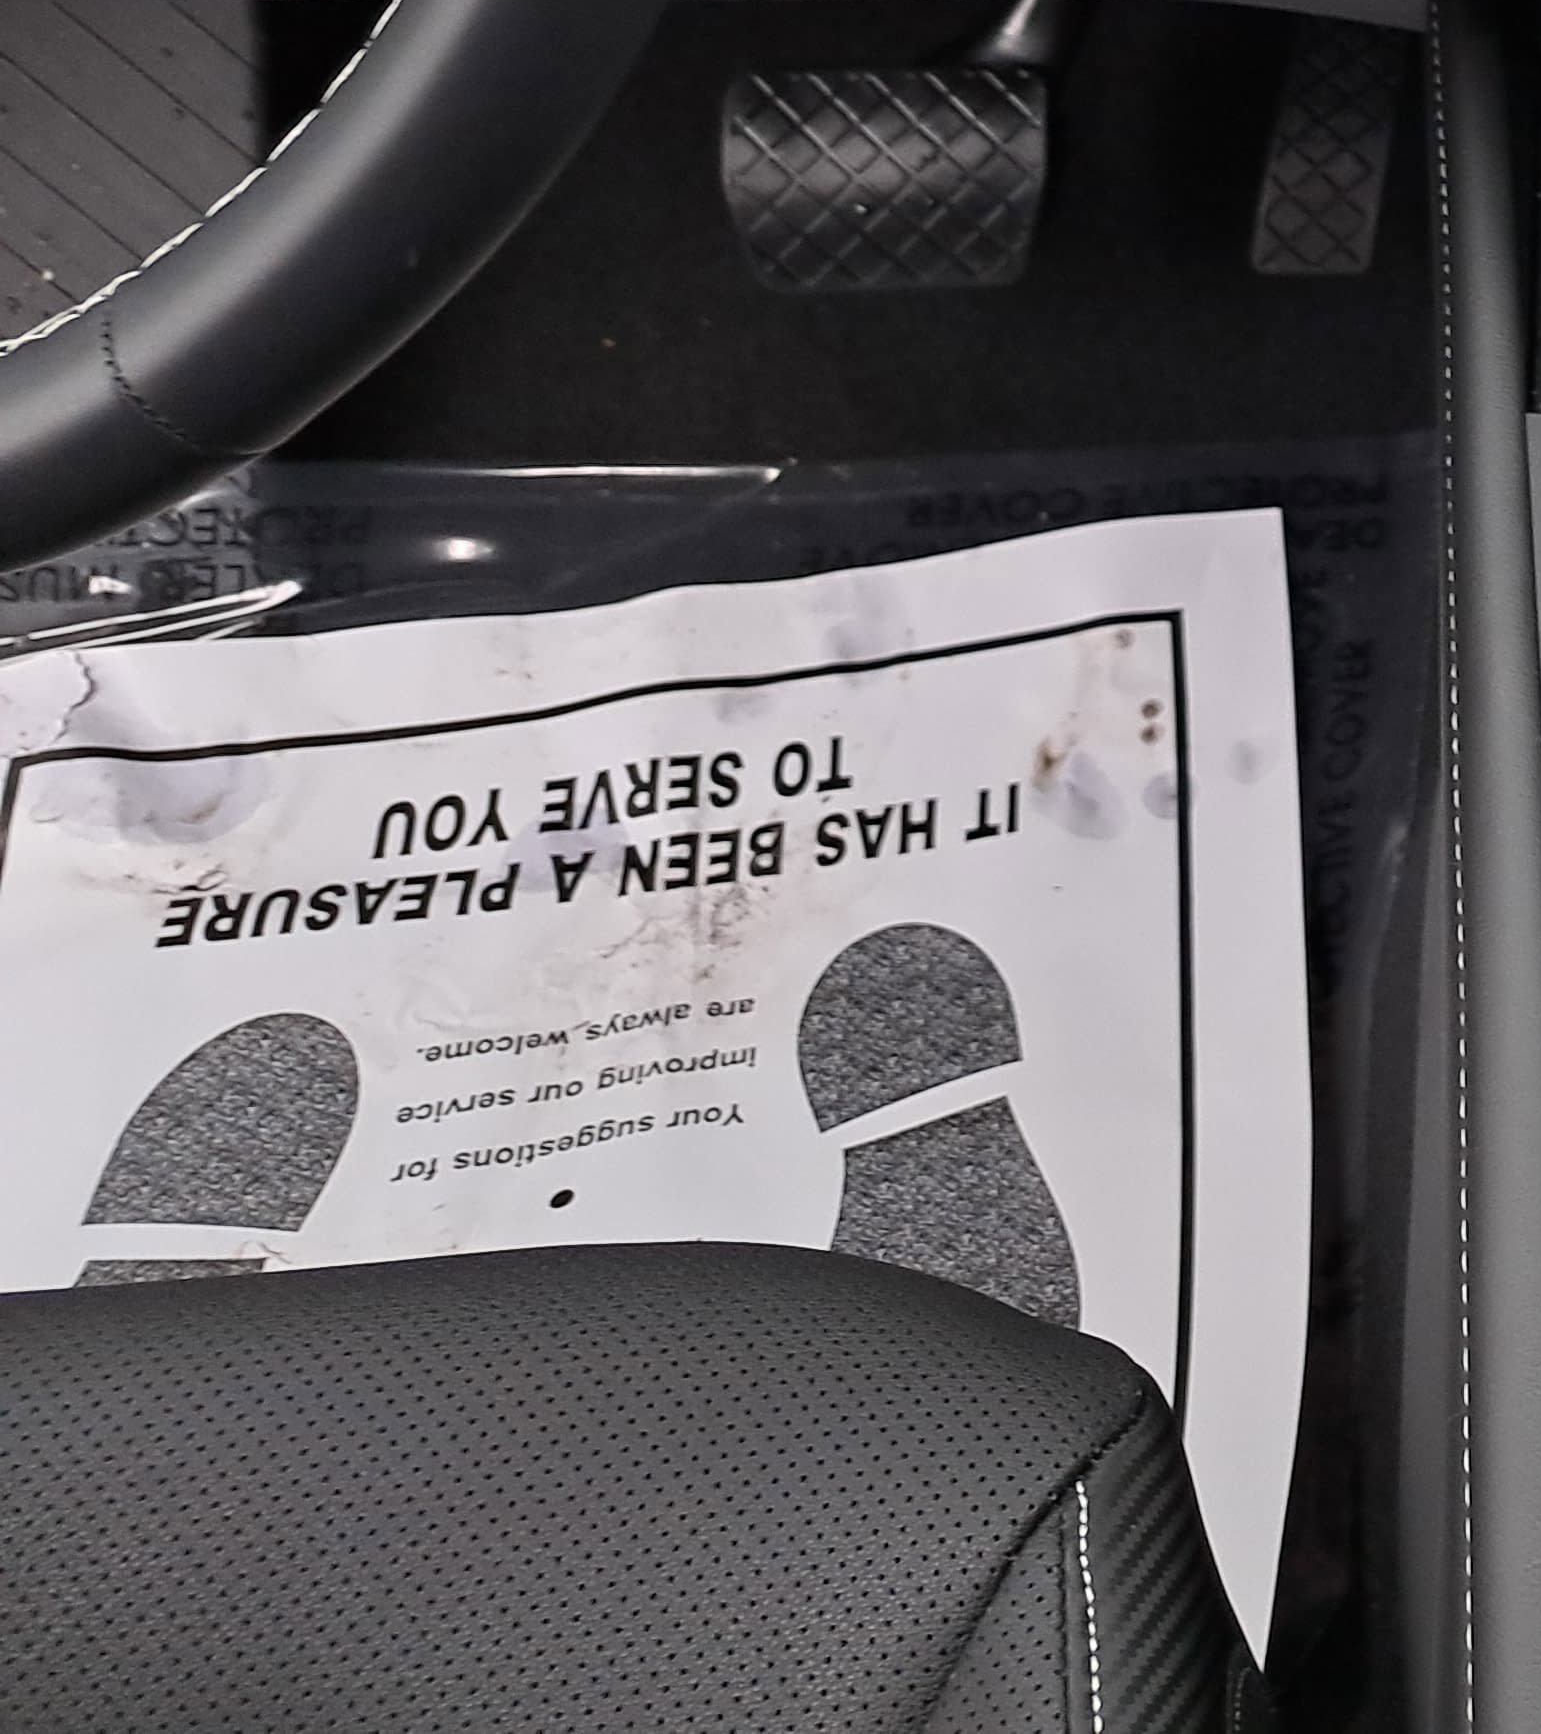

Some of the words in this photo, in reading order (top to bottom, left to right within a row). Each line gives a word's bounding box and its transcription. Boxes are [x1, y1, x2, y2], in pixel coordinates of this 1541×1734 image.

[539, 752, 743, 833] SERVE
[774, 737, 851, 797] TO
[373, 789, 508, 859] YOU
[816, 799, 936, 867] HAS
[965, 784, 1018, 841] IT
[551, 851, 594, 903] A
[618, 822, 784, 896] BEEN
[156, 863, 520, 948] PLEASURE
[586, 1003, 691, 1041] always
[706, 998, 755, 1018] are
[417, 1030, 569, 1062] welcome.
[597, 1047, 756, 1089] improving
[397, 1089, 515, 1123] service
[528, 1080, 583, 1103] our
[666, 1104, 744, 1128] Your
[454, 1115, 654, 1170] suggestions
[391, 1158, 437, 1182] for
